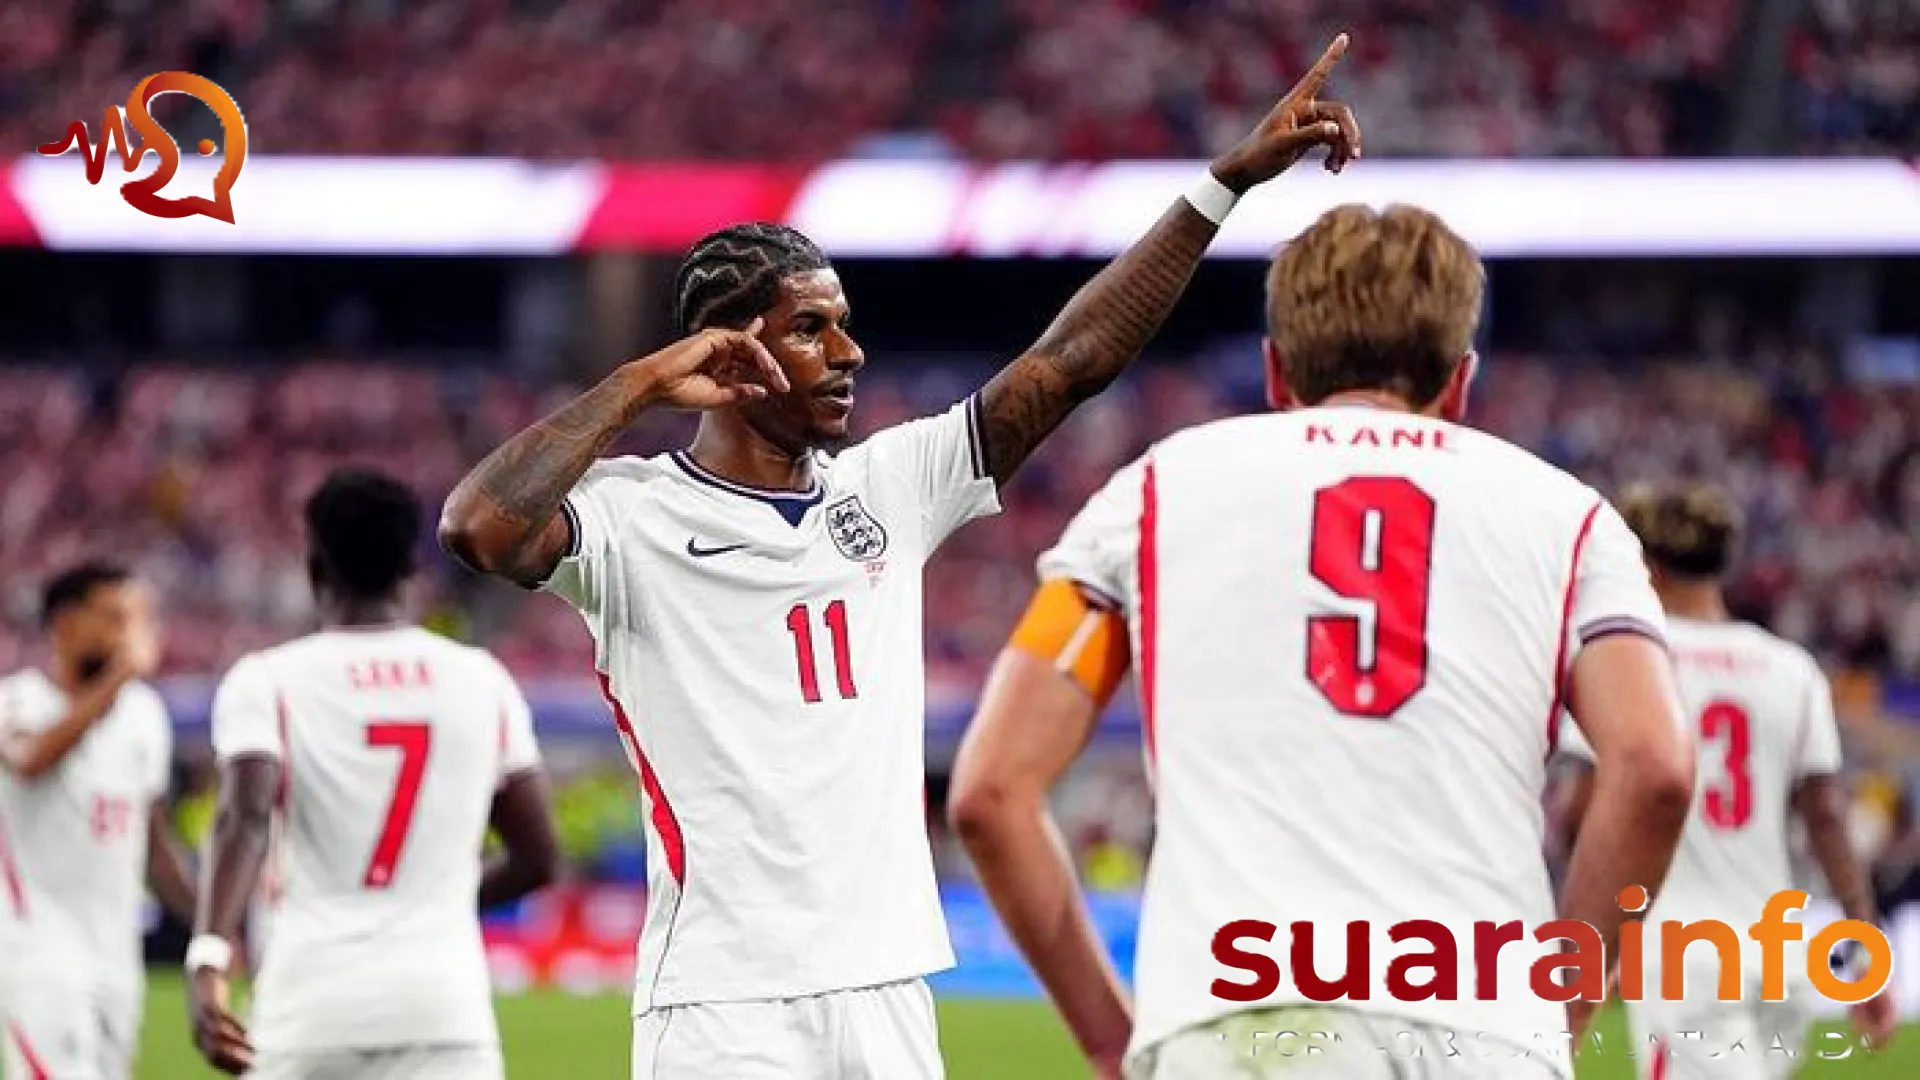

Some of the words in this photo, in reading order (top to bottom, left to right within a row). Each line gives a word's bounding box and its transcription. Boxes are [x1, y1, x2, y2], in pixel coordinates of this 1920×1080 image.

[786, 599, 858, 703] 11
[1305, 475, 1437, 719] 9
[362, 722, 432, 889] 7
[1697, 698, 1754, 831] 3
